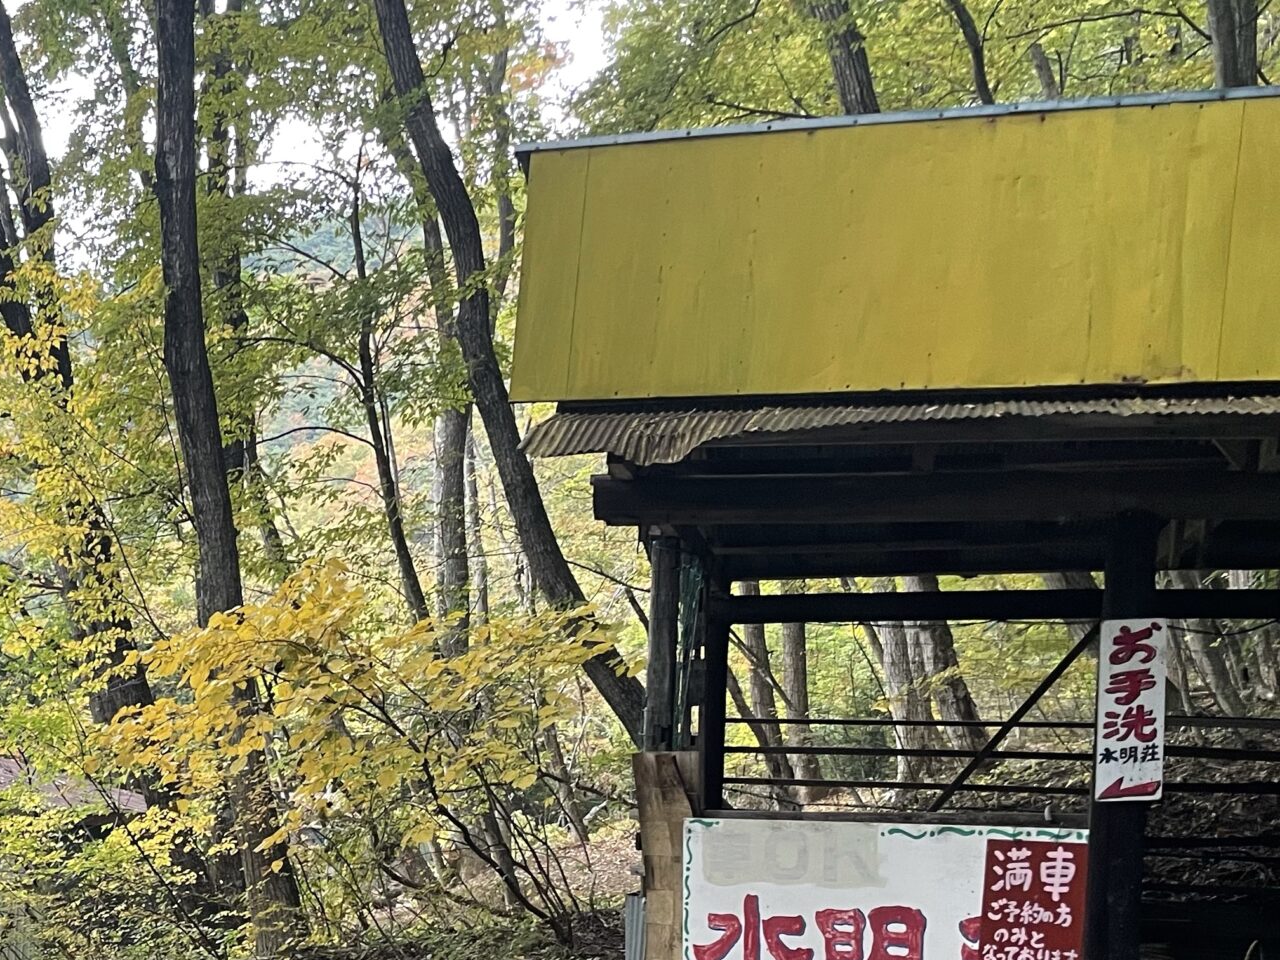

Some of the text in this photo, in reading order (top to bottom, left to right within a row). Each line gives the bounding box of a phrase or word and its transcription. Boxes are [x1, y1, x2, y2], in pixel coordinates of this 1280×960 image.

[1102, 622, 1162, 743] お手洗
[1099, 743, 1160, 765] 水明荘
[991, 846, 1076, 901] 満車
[987, 898, 1072, 927] ご予約の方
[993, 926, 1045, 949] のみと
